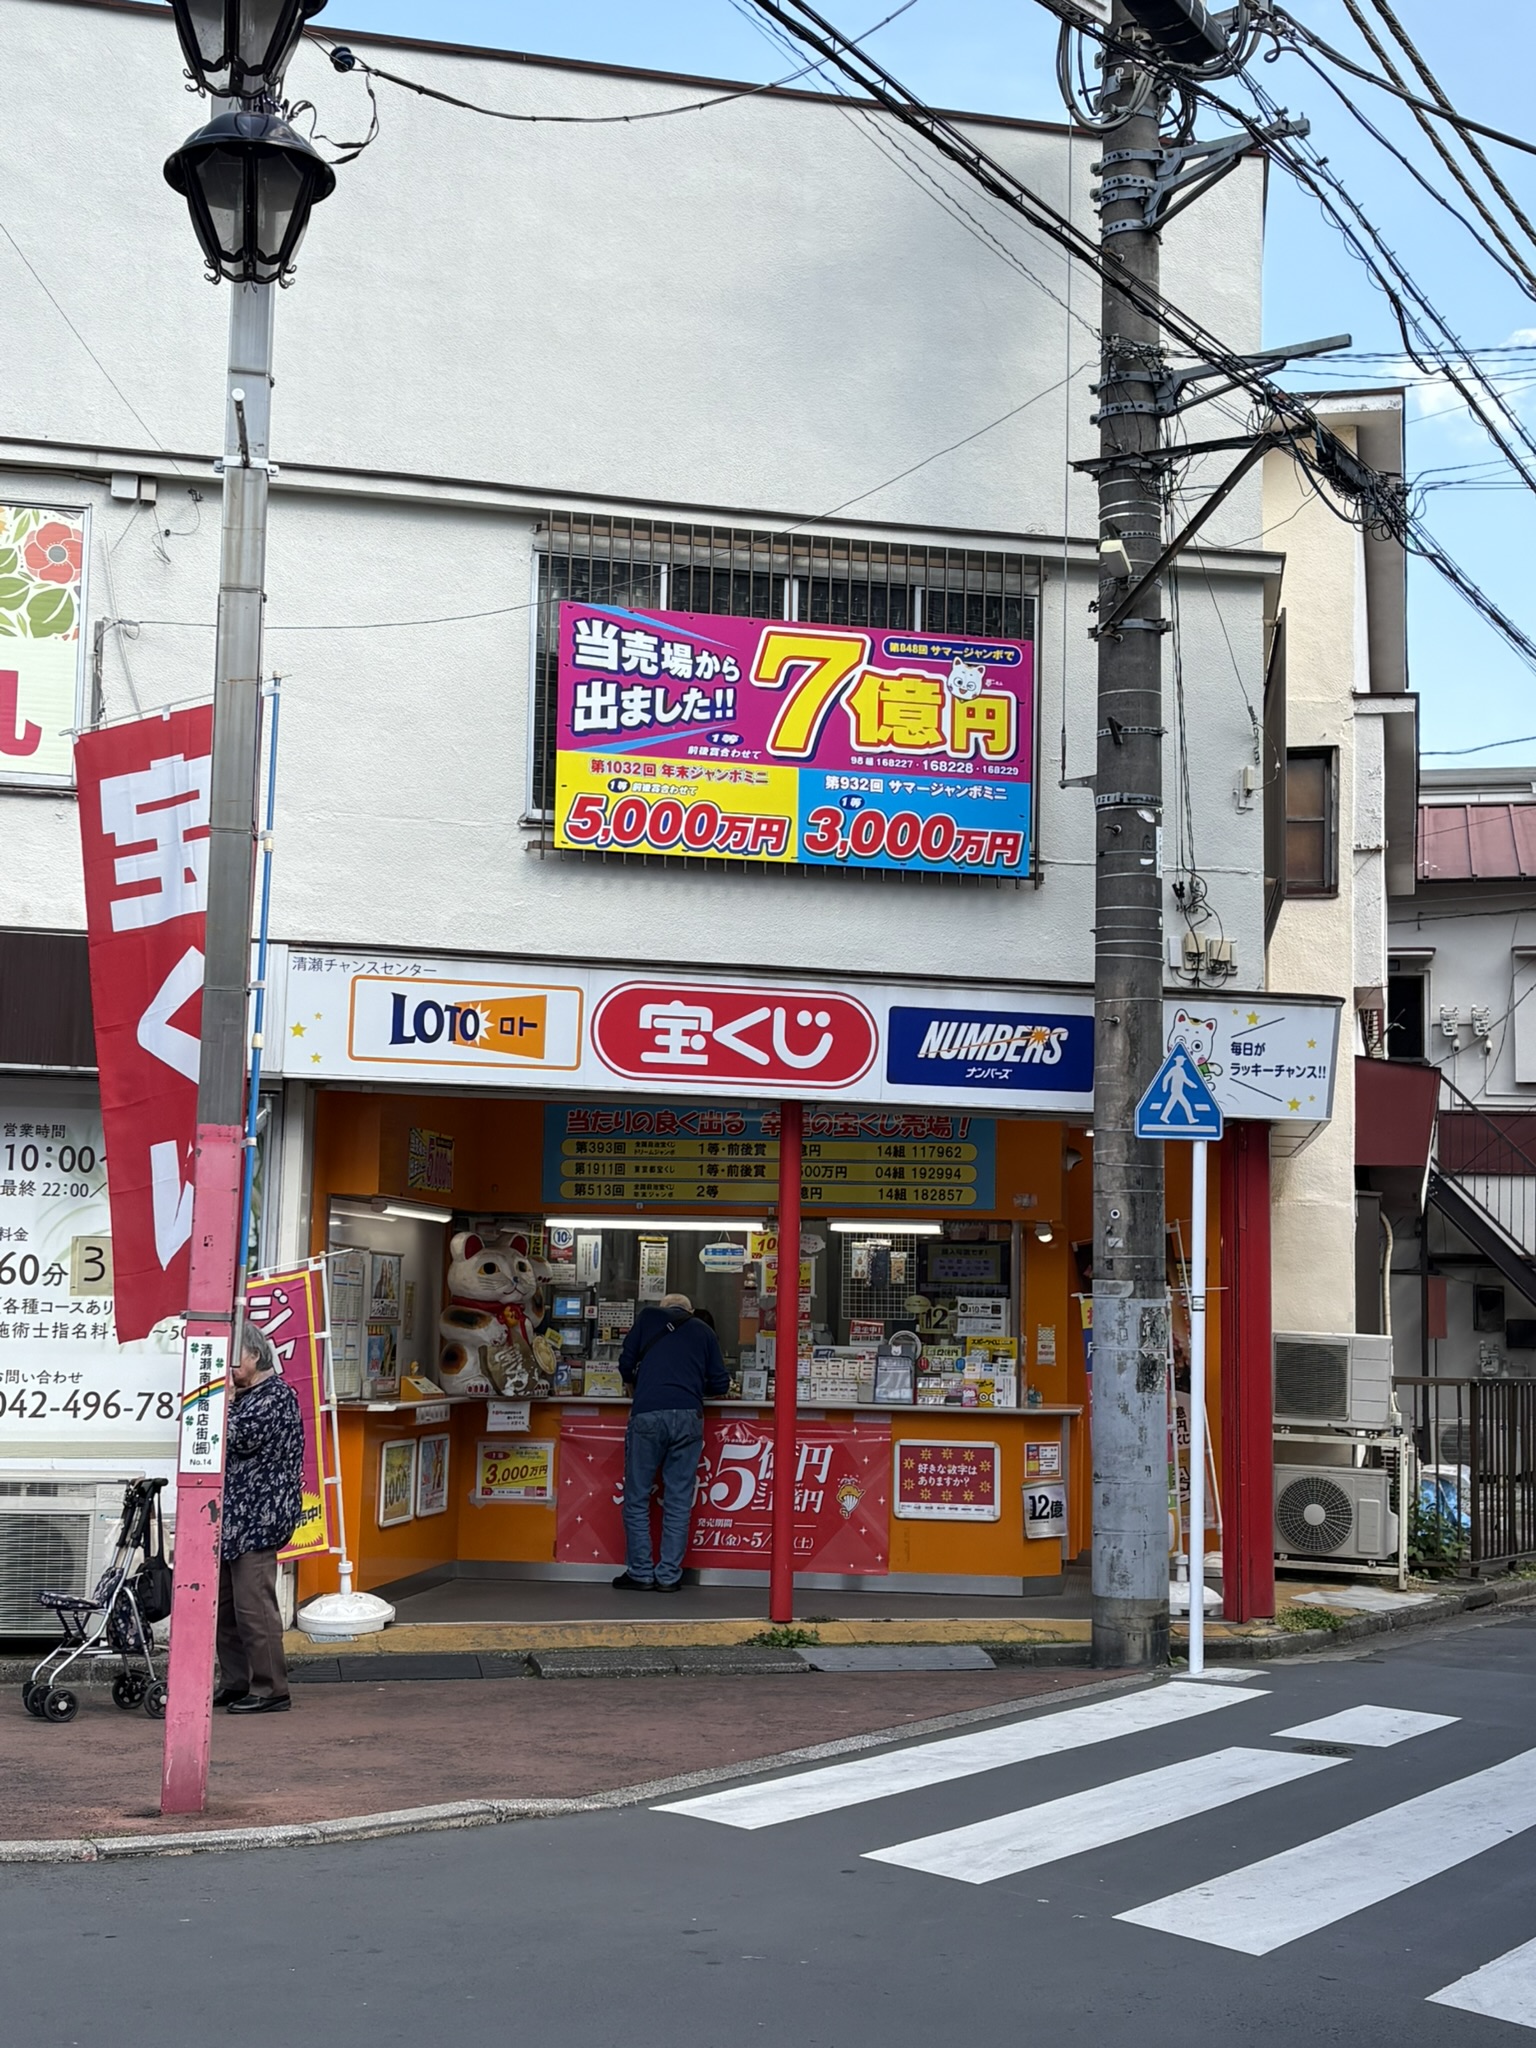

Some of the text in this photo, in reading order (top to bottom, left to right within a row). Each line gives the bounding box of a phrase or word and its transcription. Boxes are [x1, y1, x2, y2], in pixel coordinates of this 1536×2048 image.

[575, 620, 741, 682] 当売場から
[930, 643, 1015, 663] サマージャンボで
[753, 628, 1013, 756] 7億円
[574, 681, 735, 732] 出ました!!
[590, 758, 769, 785] 第1032回 年末ジャンボミニ
[825, 774, 1008, 801] 第932回 サマージャンボミニ
[566, 795, 789, 852] 5,000万円
[804, 805, 1025, 867] 3,000万円
[291, 955, 438, 977] 清瀬チャンスセンター
[389, 991, 539, 1046] LOTO ロト
[639, 999, 834, 1070] 宝くじ
[917, 1020, 1069, 1066] NUMBERS
[1230, 1041, 1266, 1057] 毎日が
[964, 1066, 1014, 1081] ナンバーズ
[1229, 1062, 1327, 1080] ラッキーチャンス!!
[3, 1122, 67, 1140] 営業時間
[566, 1108, 972, 1140] 当たりの良く出る 幸の宝くじ売場!
[575, 1141, 627, 1155] 第393回
[912, 1145, 962, 1159] 117962
[574, 1162, 626, 1176] 第1911回
[911, 1167, 962, 1181] 192994
[0, 1179, 37, 1197] 最終
[574, 1183, 625, 1197] 第513回
[696, 1185, 719, 1199] 2等
[912, 1188, 963, 1202] 182857
[0, 1227, 29, 1242] 料金
[0, 1251, 69, 1287] 60分
[0, 1369, 84, 1385] 問い合わせ
[189, 1458, 212, 1467] No.14
[917, 1463, 978, 1475] 好きな数字は
[917, 1476, 970, 1488] ありますか?
[1028, 1494, 1064, 1521] 12億
